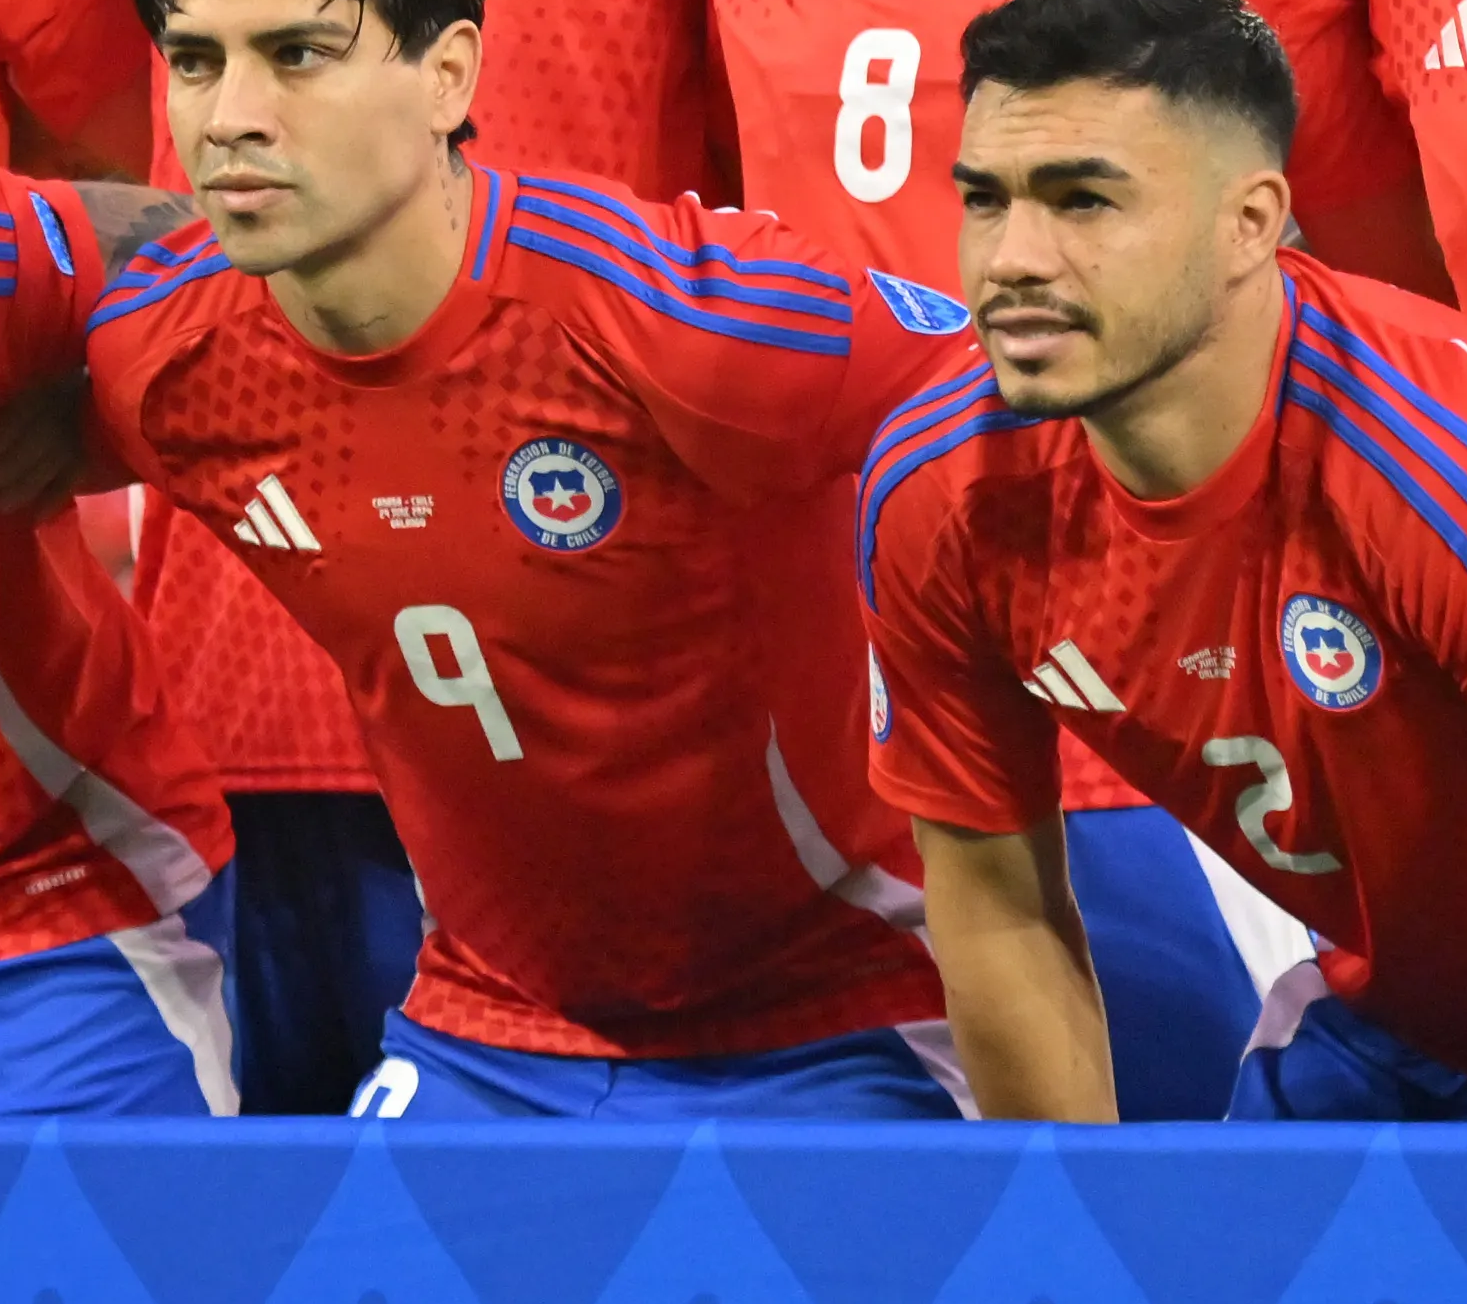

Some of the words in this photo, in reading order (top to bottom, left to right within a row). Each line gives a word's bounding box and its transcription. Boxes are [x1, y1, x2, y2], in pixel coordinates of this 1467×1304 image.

[833, 27, 922, 203] 8
[559, 441, 575, 457] DE
[393, 604, 524, 762] 9
[1201, 735, 1343, 875] 2
